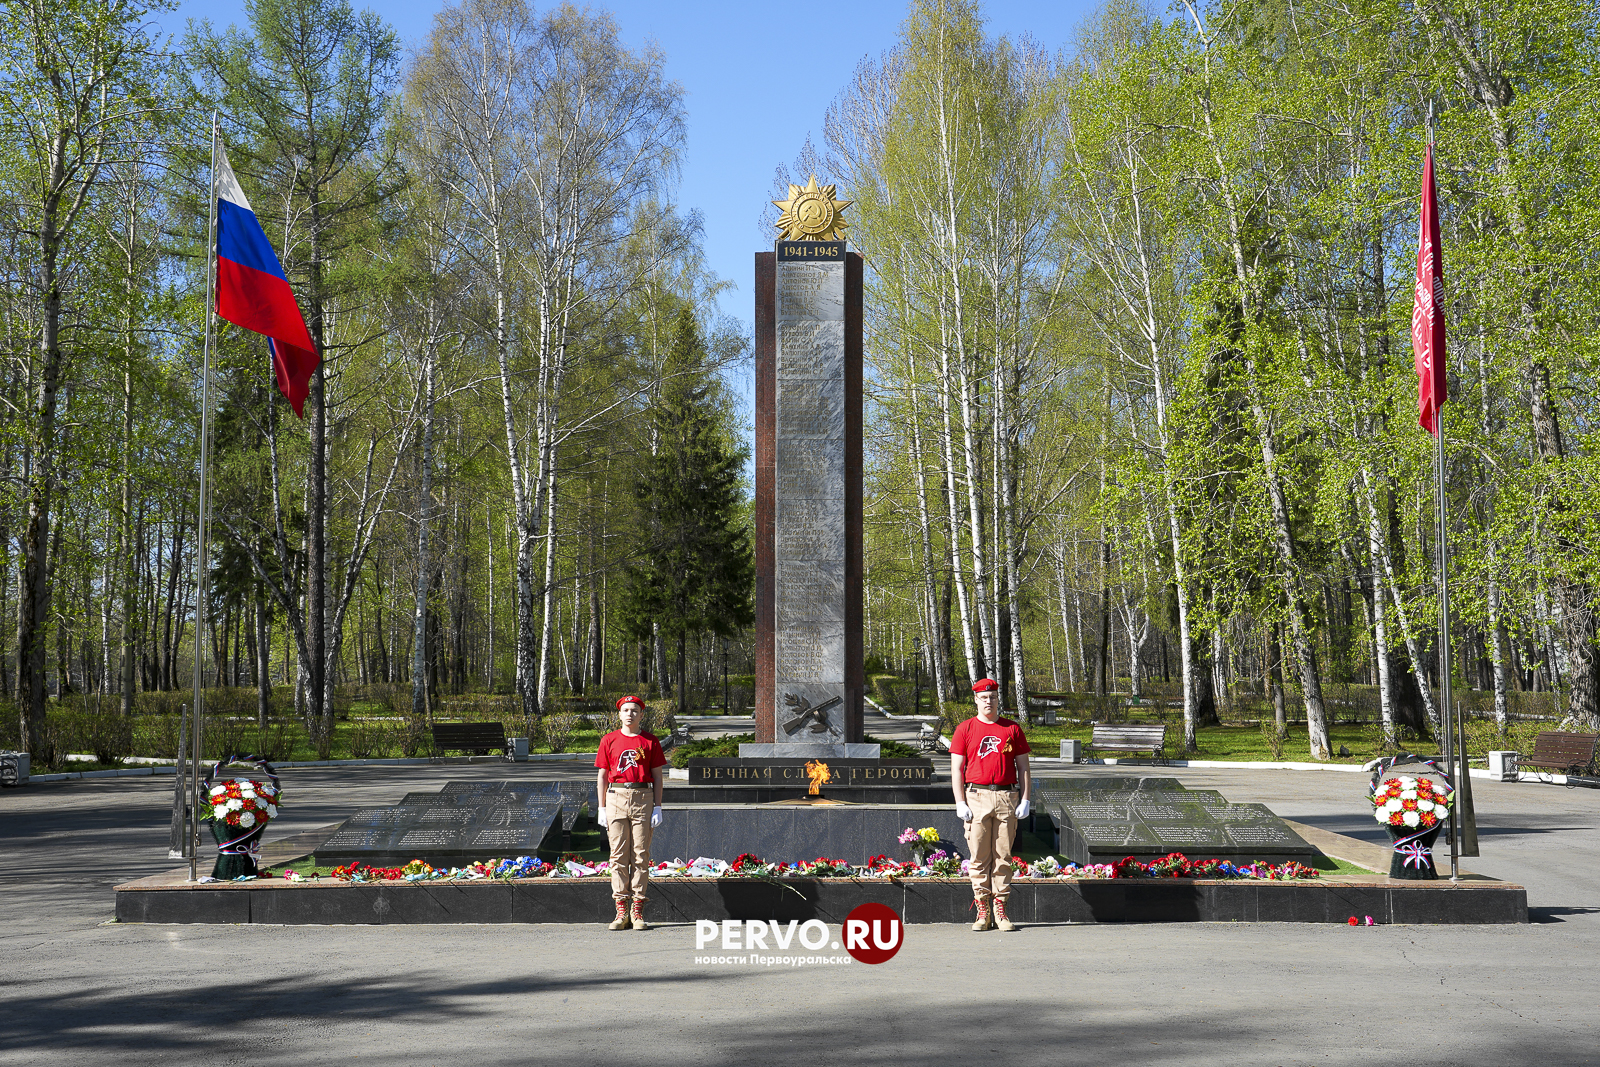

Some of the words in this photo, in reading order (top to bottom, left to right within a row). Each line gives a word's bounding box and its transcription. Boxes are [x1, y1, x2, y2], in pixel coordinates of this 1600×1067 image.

[783, 246, 839, 257] 1941-1945
[702, 767, 772, 779] ВЕЧНАЯ
[783, 767, 841, 779] СЛА
